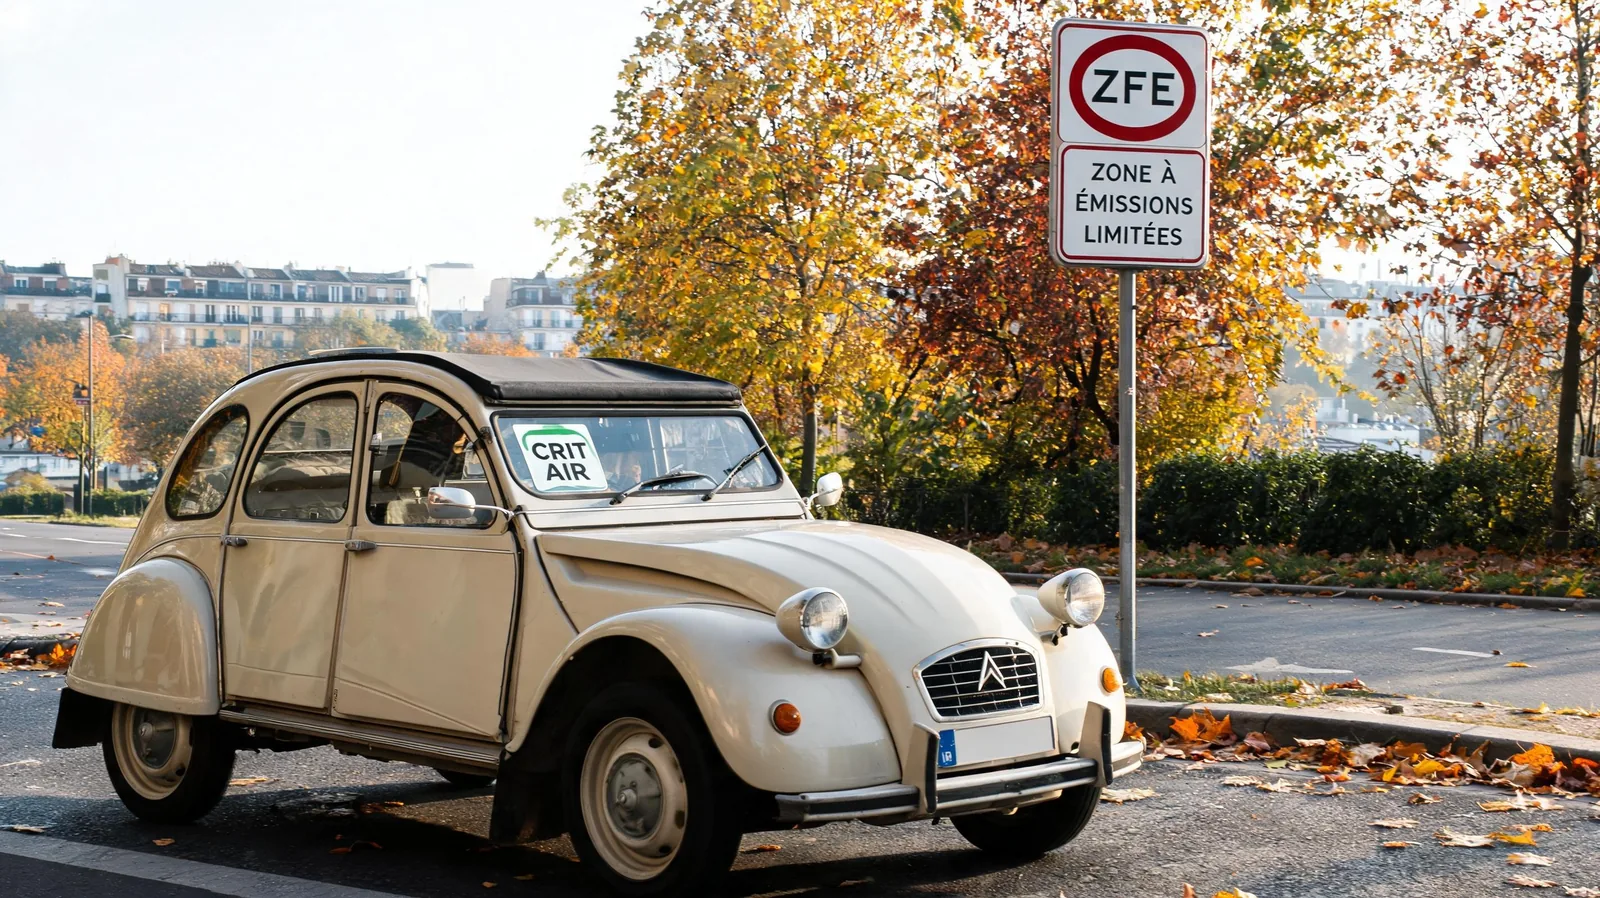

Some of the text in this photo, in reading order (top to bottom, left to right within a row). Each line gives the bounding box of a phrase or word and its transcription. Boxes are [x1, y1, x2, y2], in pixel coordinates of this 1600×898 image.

[1091, 69, 1175, 106] ZFE
[1091, 159, 1176, 184] ZONE À
[1075, 188, 1193, 215] ÉMISSIONS
[1084, 222, 1183, 246] LIMITÉES
[531, 442, 586, 460] CRIT
[546, 463, 591, 481] AIR
